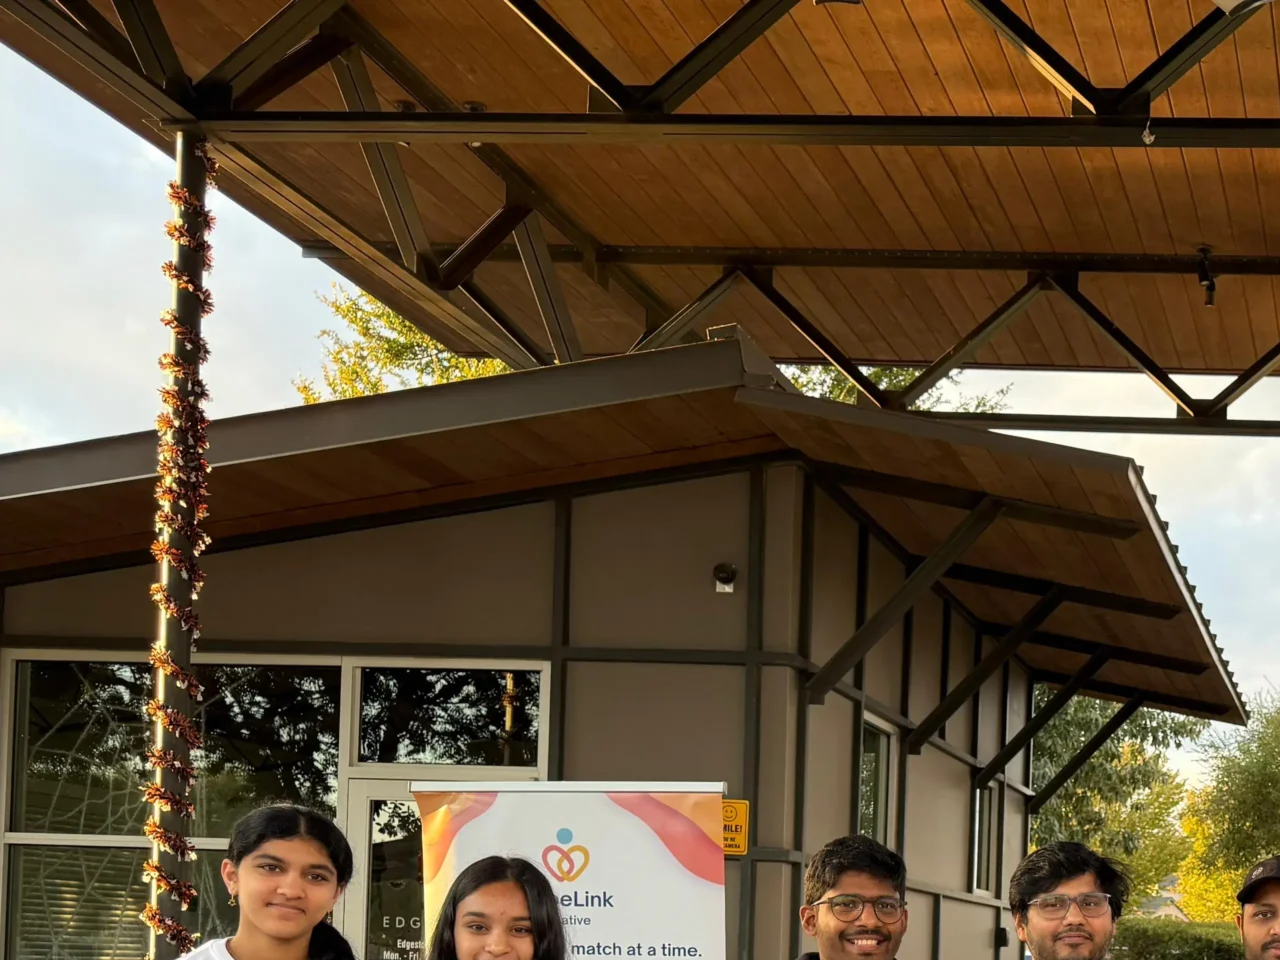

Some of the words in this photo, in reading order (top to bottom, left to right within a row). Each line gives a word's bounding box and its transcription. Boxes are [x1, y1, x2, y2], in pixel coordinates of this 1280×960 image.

[722, 824, 742, 832] MILE!
[557, 890, 614, 908] eLink
[383, 916, 421, 929] EDG
[561, 915, 592, 926] ative
[383, 950, 402, 960] Mon.
[571, 942, 622, 956] match
[626, 943, 642, 957] at
[647, 946, 657, 957] a
[661, 943, 702, 958] time.
